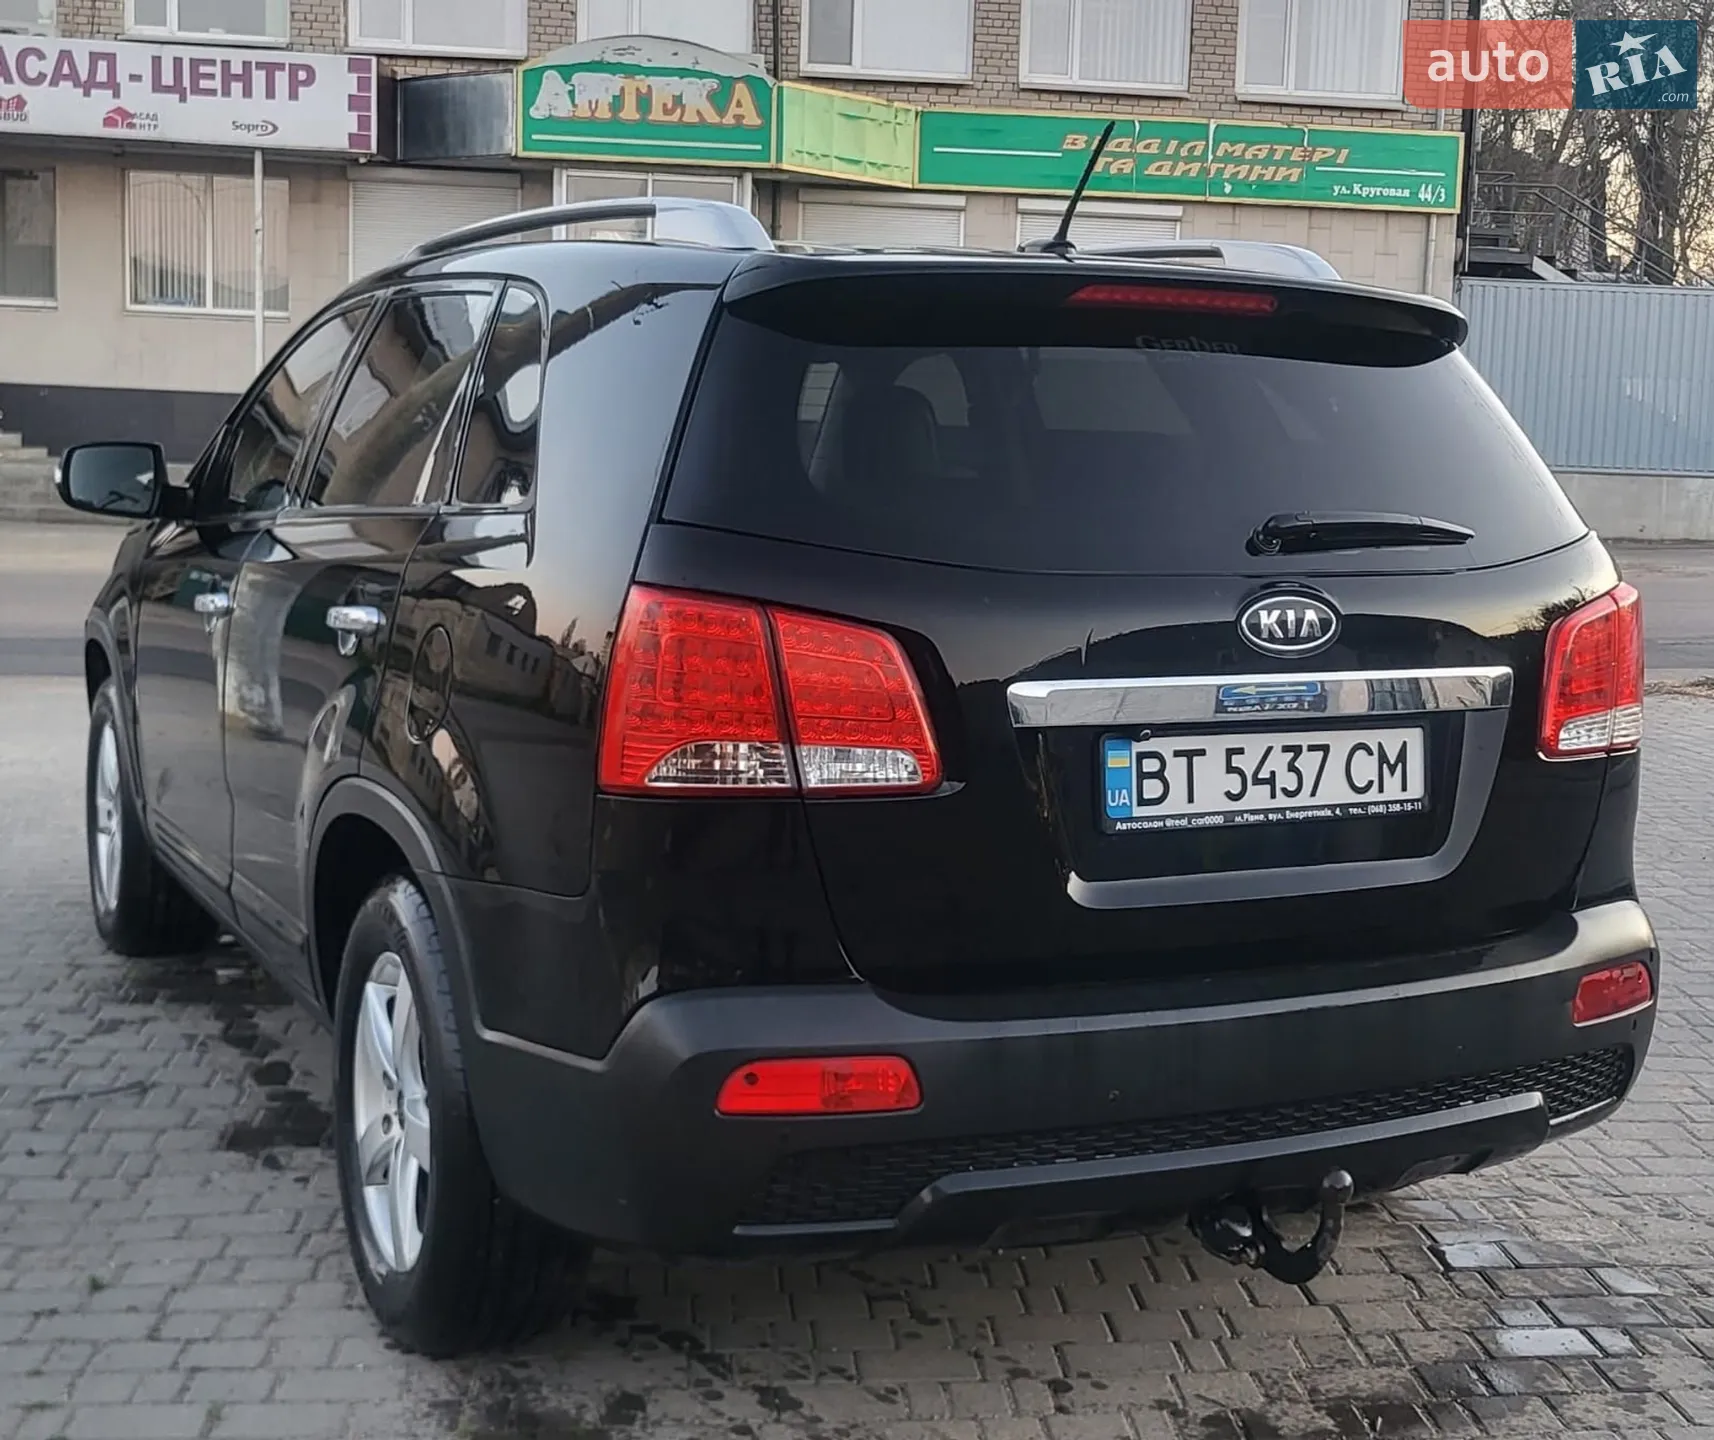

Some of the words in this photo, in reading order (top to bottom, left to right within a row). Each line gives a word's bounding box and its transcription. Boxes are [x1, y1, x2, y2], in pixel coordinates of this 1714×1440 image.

[231, 120, 269, 134] Sopro
[1215, 141, 1350, 164] МАТЕРІ
[1144, 160, 1303, 182] ДИТИНИ
[1333, 184, 1351, 196] ул.
[1352, 183, 1411, 198] Круговая
[1418, 183, 1446, 205] 44/3
[1257, 608, 1322, 639] KIA
[1135, 748, 1207, 807] BT
[1224, 743, 1331, 802] 5437
[1345, 739, 1408, 795] CM
[1106, 788, 1131, 807] UA
